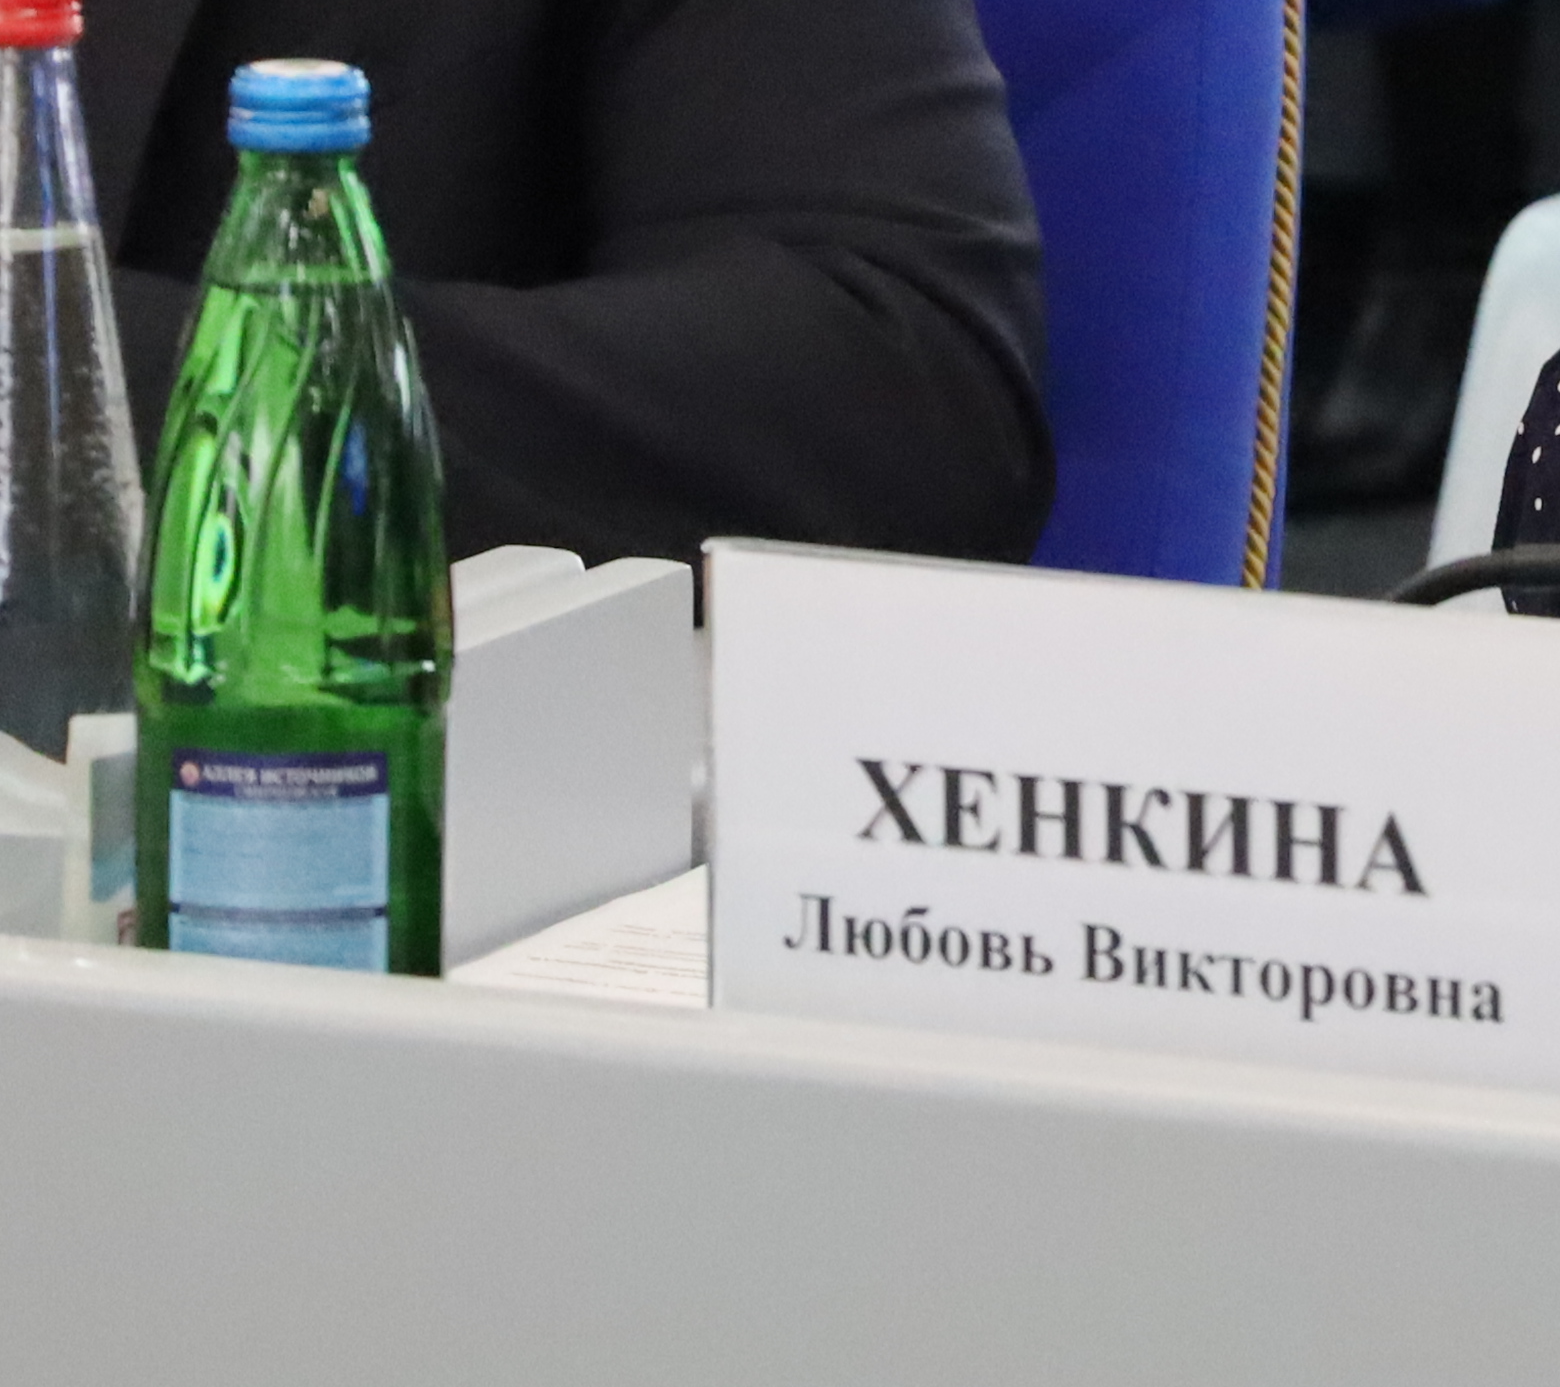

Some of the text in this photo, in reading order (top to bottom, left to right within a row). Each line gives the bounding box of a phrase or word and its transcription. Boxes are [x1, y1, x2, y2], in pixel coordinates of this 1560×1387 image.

[855, 757, 1429, 898] ХЕНКИНА
[782, 893, 1055, 977] Любовь
[1081, 922, 1505, 1025] Викторовна
